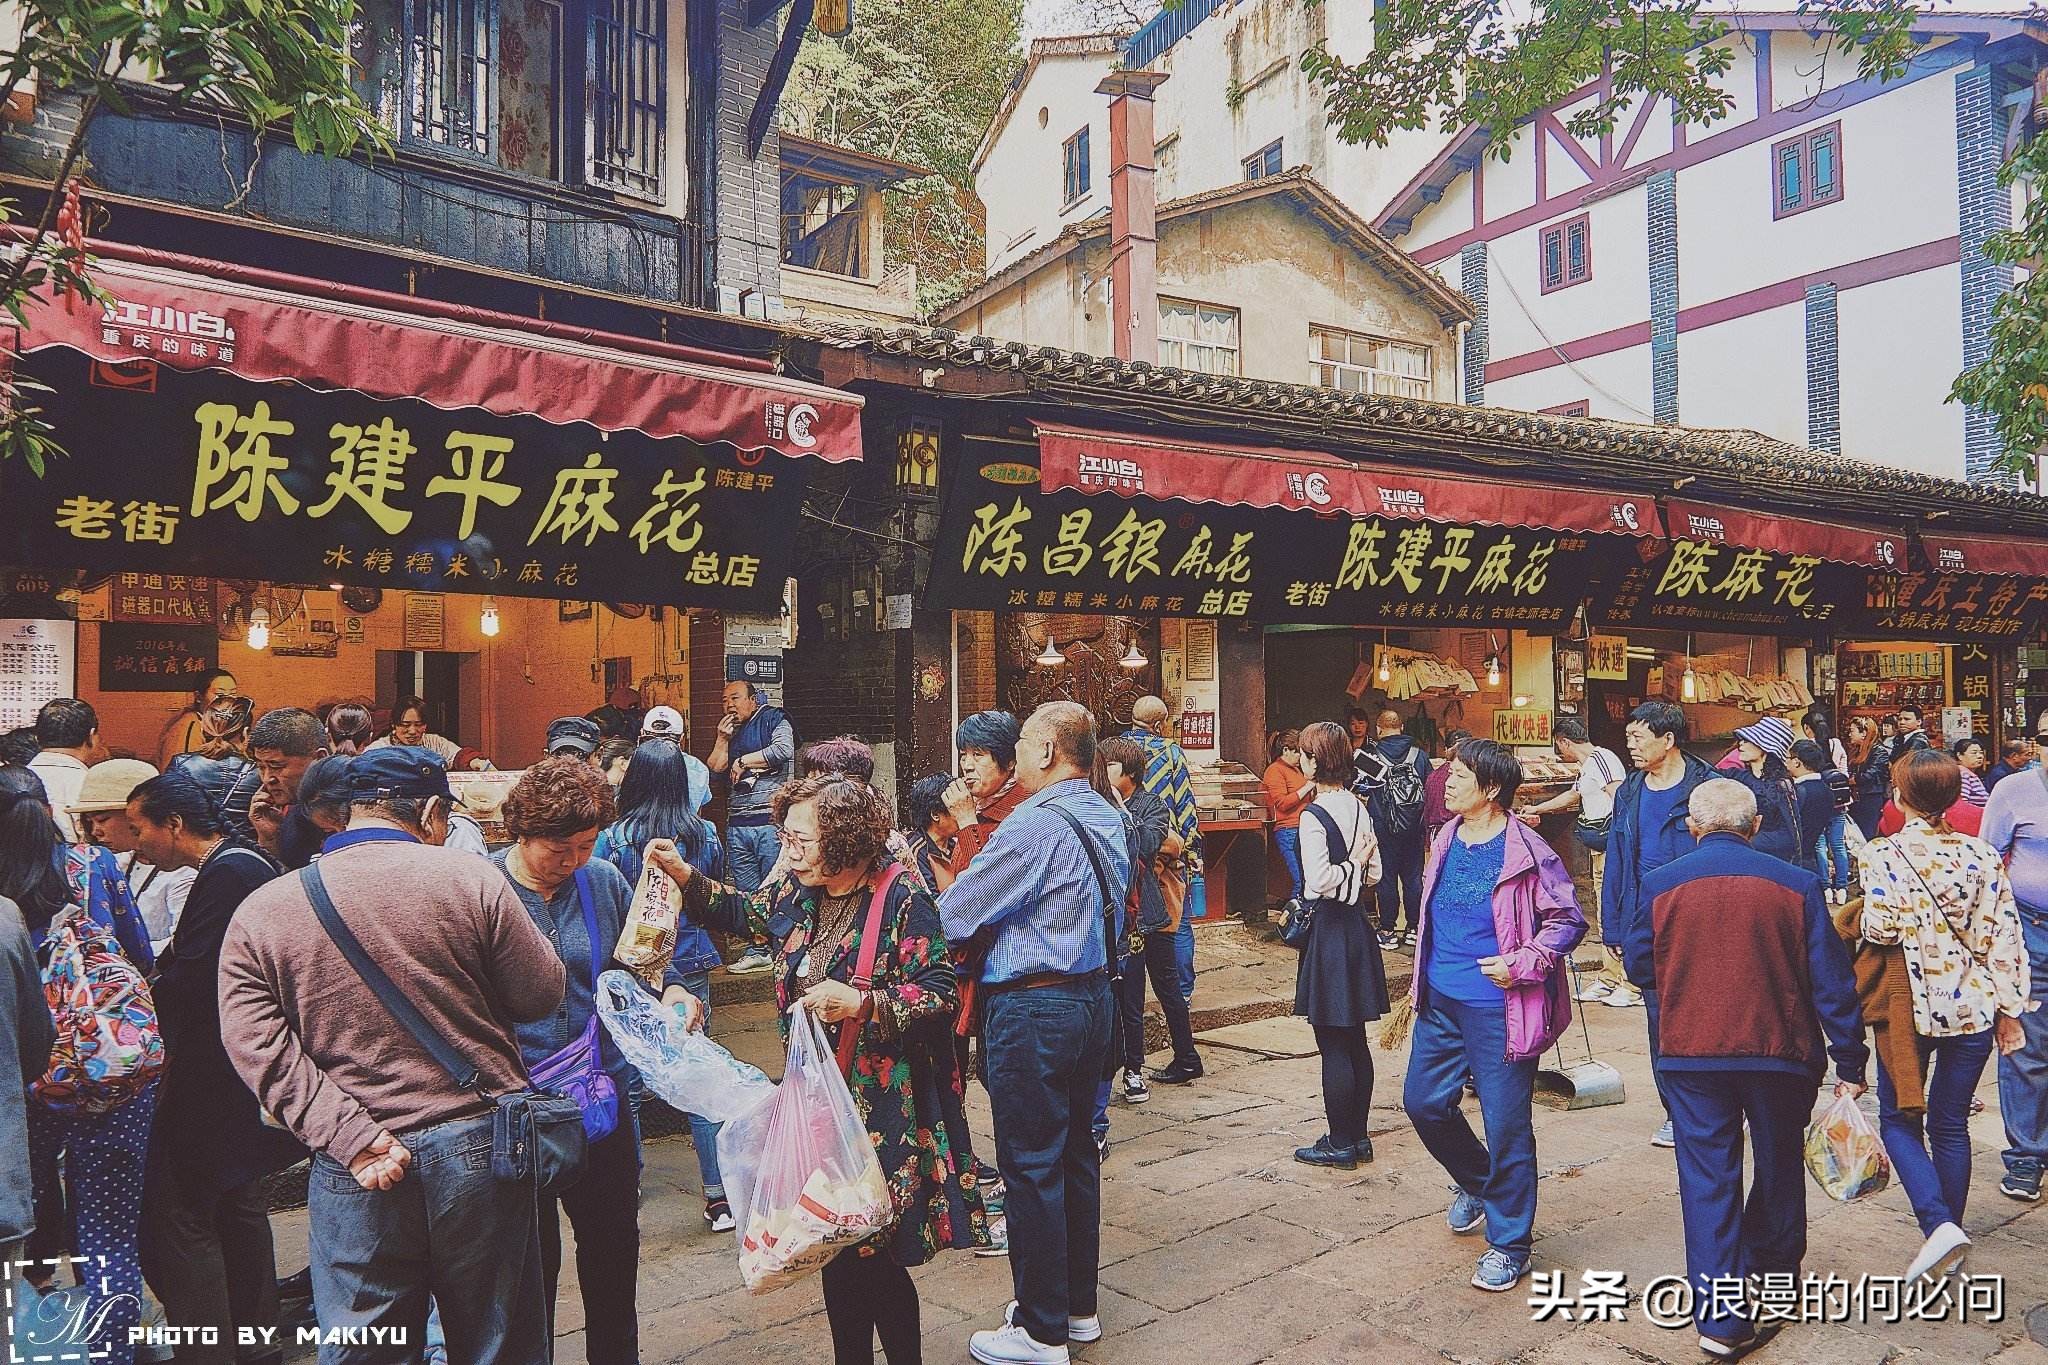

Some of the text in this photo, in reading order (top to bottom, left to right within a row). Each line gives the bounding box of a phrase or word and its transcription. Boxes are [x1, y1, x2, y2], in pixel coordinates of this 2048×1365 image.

[101, 301, 235, 341] 江小白
[101, 329, 234, 363] 重庆的味道
[190, 400, 706, 554] 陈建平麻花
[715, 468, 774, 494] 陈建平
[1079, 454, 1143, 477] 江小白
[1377, 486, 1425, 504] 江小白
[55, 495, 180, 545] 老街
[1688, 514, 1724, 530] 江小白
[323, 543, 578, 587] 冰糖糯米小麻花
[685, 550, 760, 588] 总店
[1335, 518, 1556, 597] 陈建平麻花
[1655, 540, 1824, 608] 陈麻花
[1008, 589, 1185, 613] 冰糖糯米小麻花
[1197, 588, 1253, 616] 总店
[1284, 581, 1332, 608] 老街
[1496, 713, 1550, 741] 代收快递
